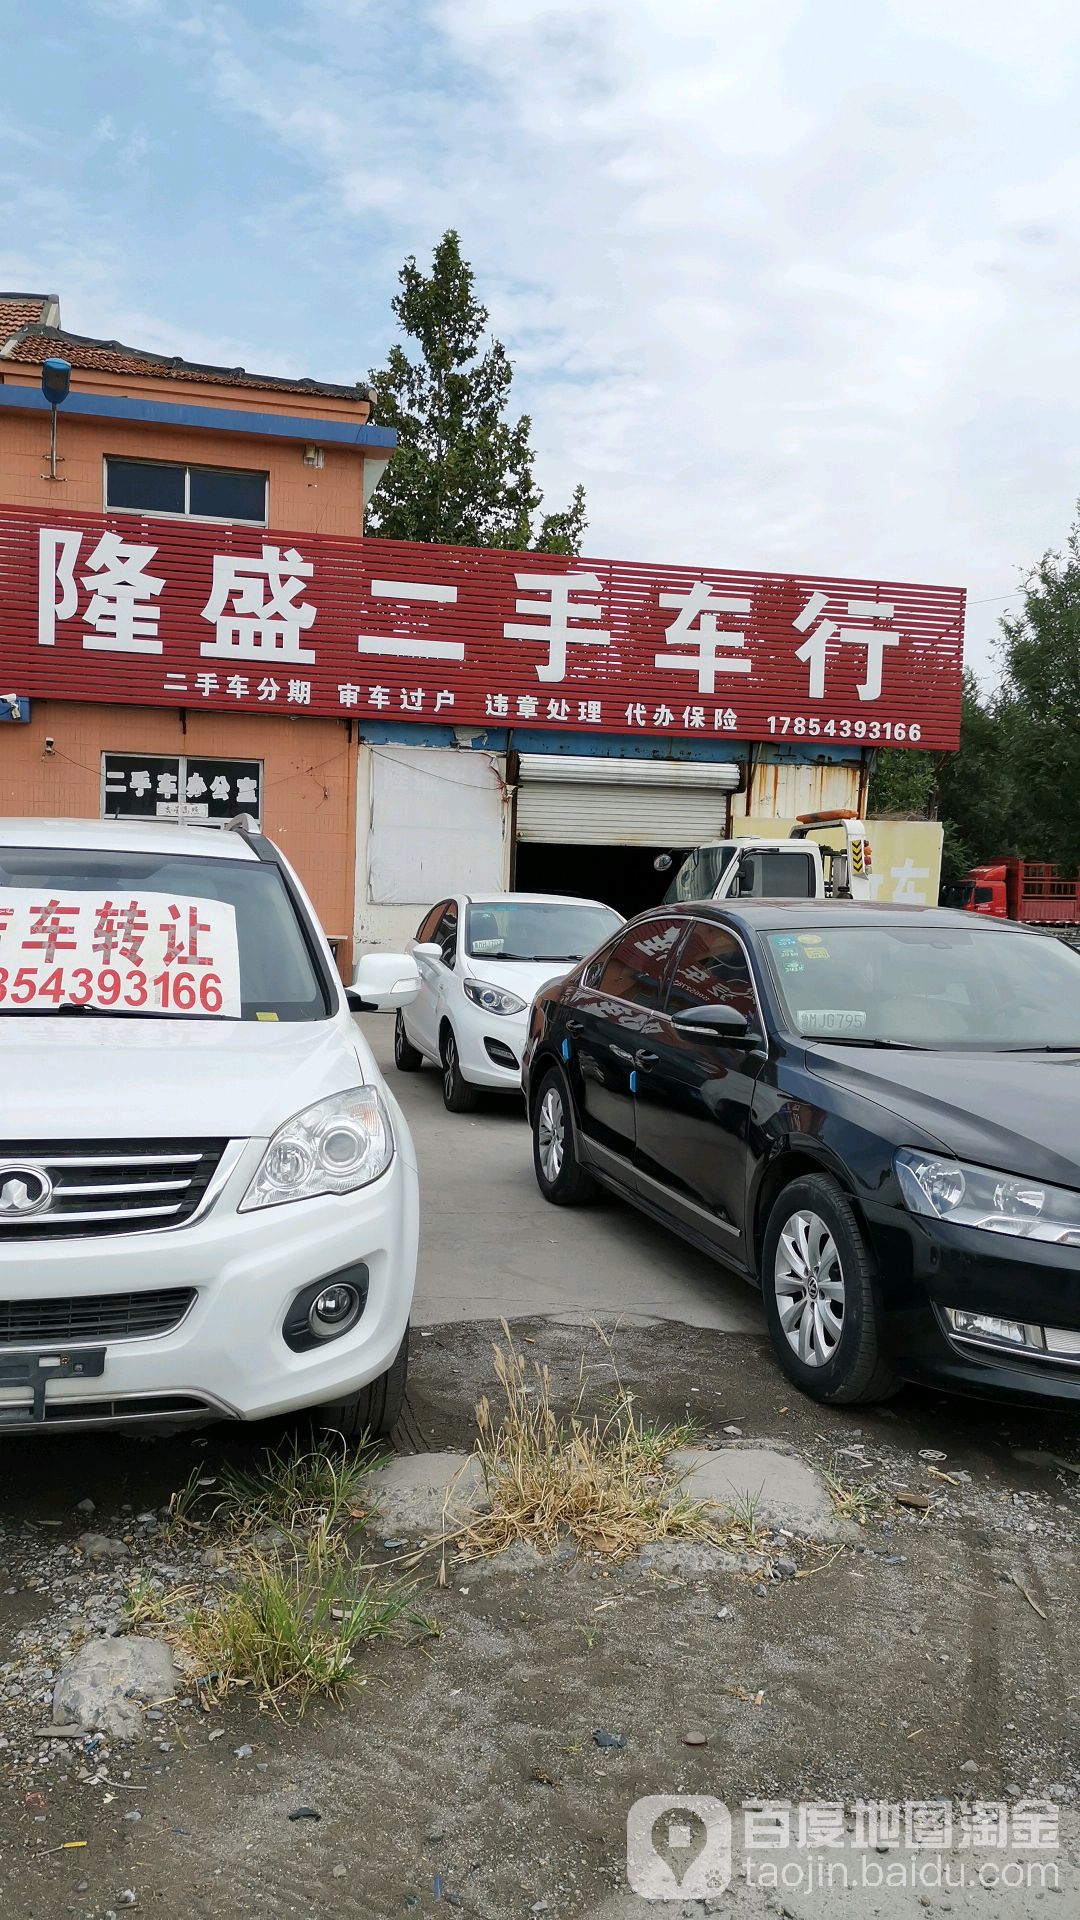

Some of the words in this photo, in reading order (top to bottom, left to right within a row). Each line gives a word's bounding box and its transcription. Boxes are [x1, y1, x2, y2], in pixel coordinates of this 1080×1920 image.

[39, 527, 899, 701] 隆盛二手车行
[164, 673, 312, 705] 二手车分期
[338, 684, 456, 713] 审车过户
[485, 694, 602, 723] 违章处理
[625, 702, 738, 730] 代办保险
[767, 716, 922, 742] 17854393166
[105, 770, 257, 803] 二手车办公室
